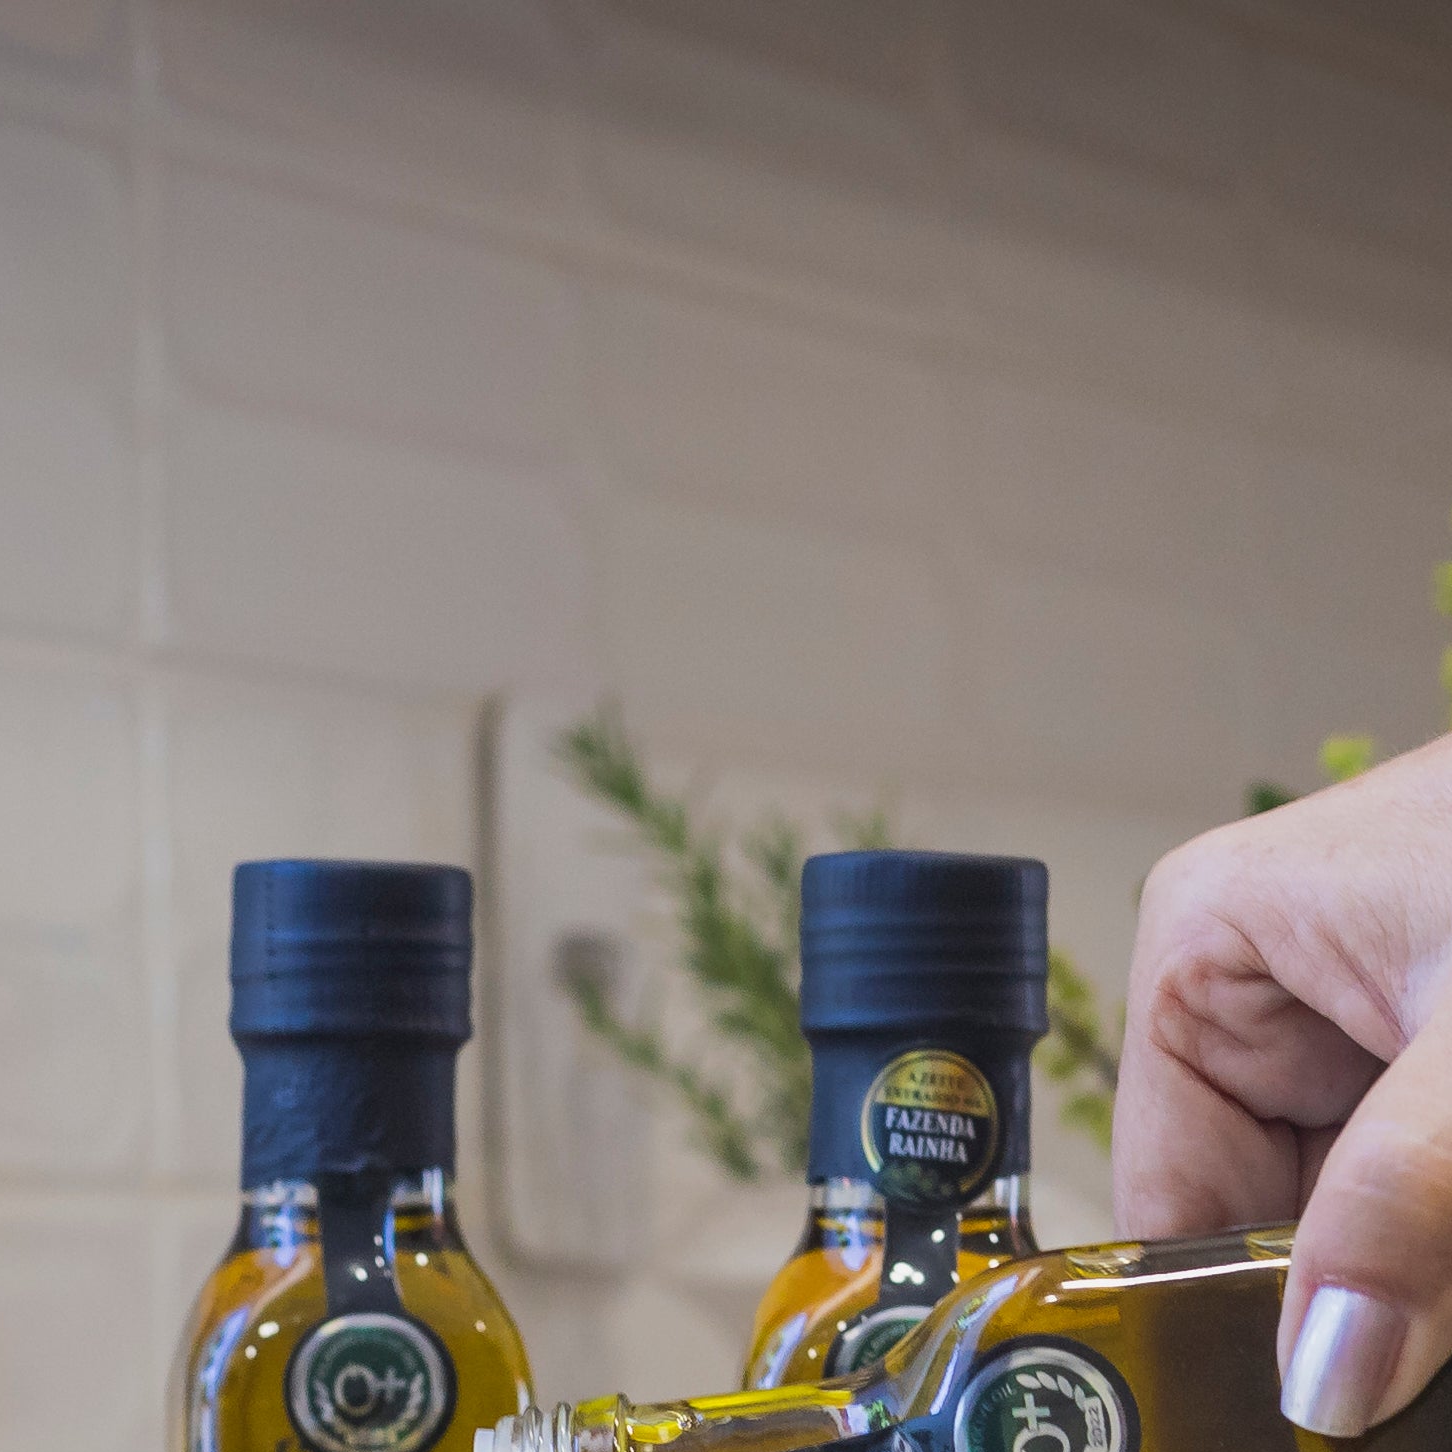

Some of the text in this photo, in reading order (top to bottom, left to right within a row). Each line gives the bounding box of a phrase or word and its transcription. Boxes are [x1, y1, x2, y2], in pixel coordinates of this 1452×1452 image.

[885, 1106, 976, 1139] FAZENDA
[889, 1132, 967, 1162] RAINHA
[1088, 1406, 1105, 1447] 2022
